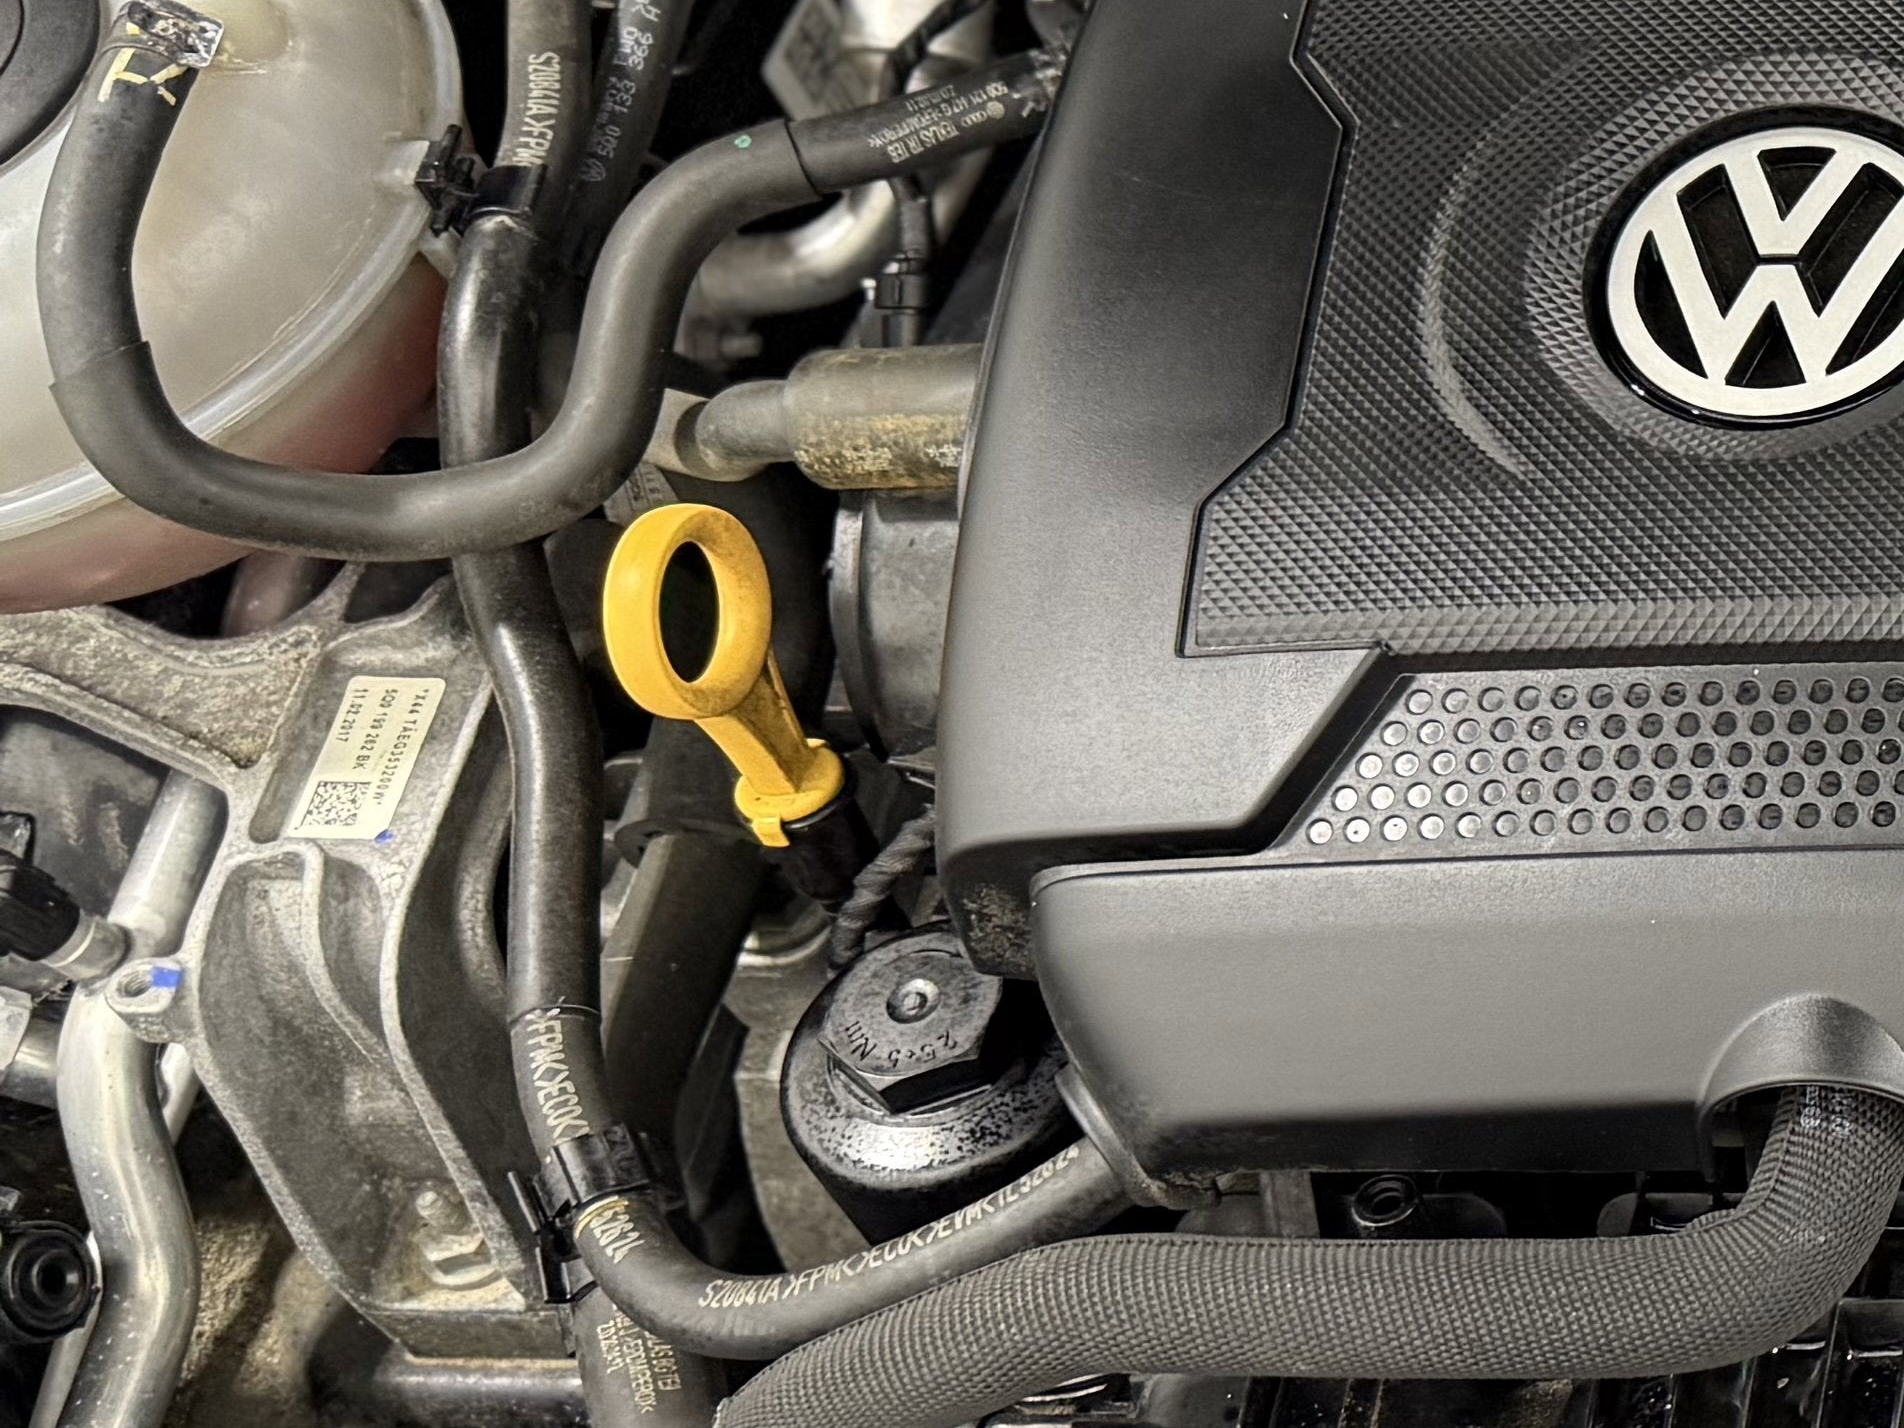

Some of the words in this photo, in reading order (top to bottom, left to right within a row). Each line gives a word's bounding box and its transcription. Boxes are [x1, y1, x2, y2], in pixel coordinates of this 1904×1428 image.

[612, 79, 638, 116] 133
[628, 30, 658, 73] 366
[698, 1276, 783, 1308] S20841A
